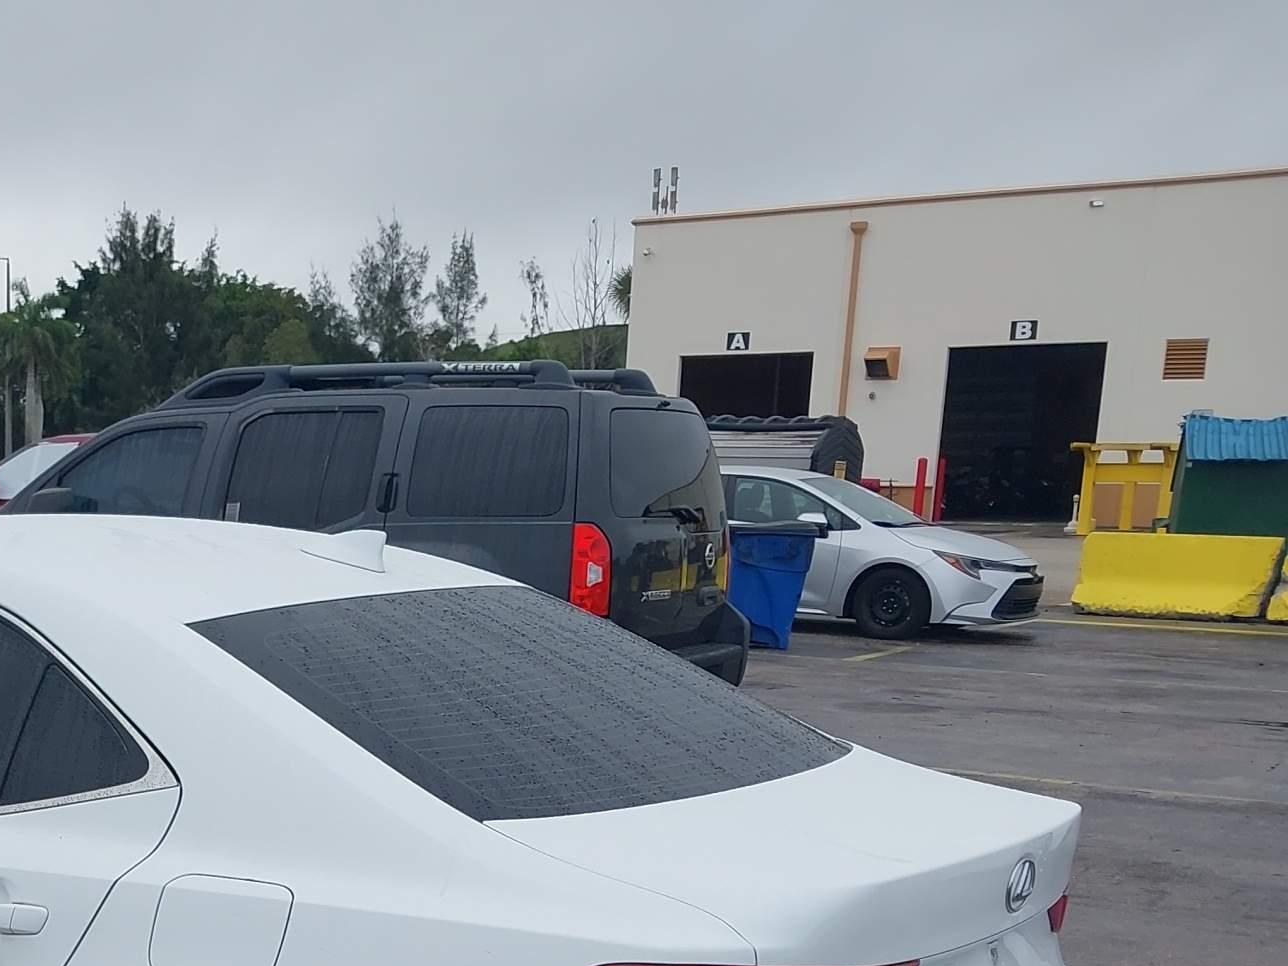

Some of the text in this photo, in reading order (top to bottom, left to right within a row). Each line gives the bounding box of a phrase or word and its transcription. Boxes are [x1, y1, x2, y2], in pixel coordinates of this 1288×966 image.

[1015, 321, 1032, 339] B
[730, 333, 746, 349] A
[441, 362, 520, 373] XTERRA
